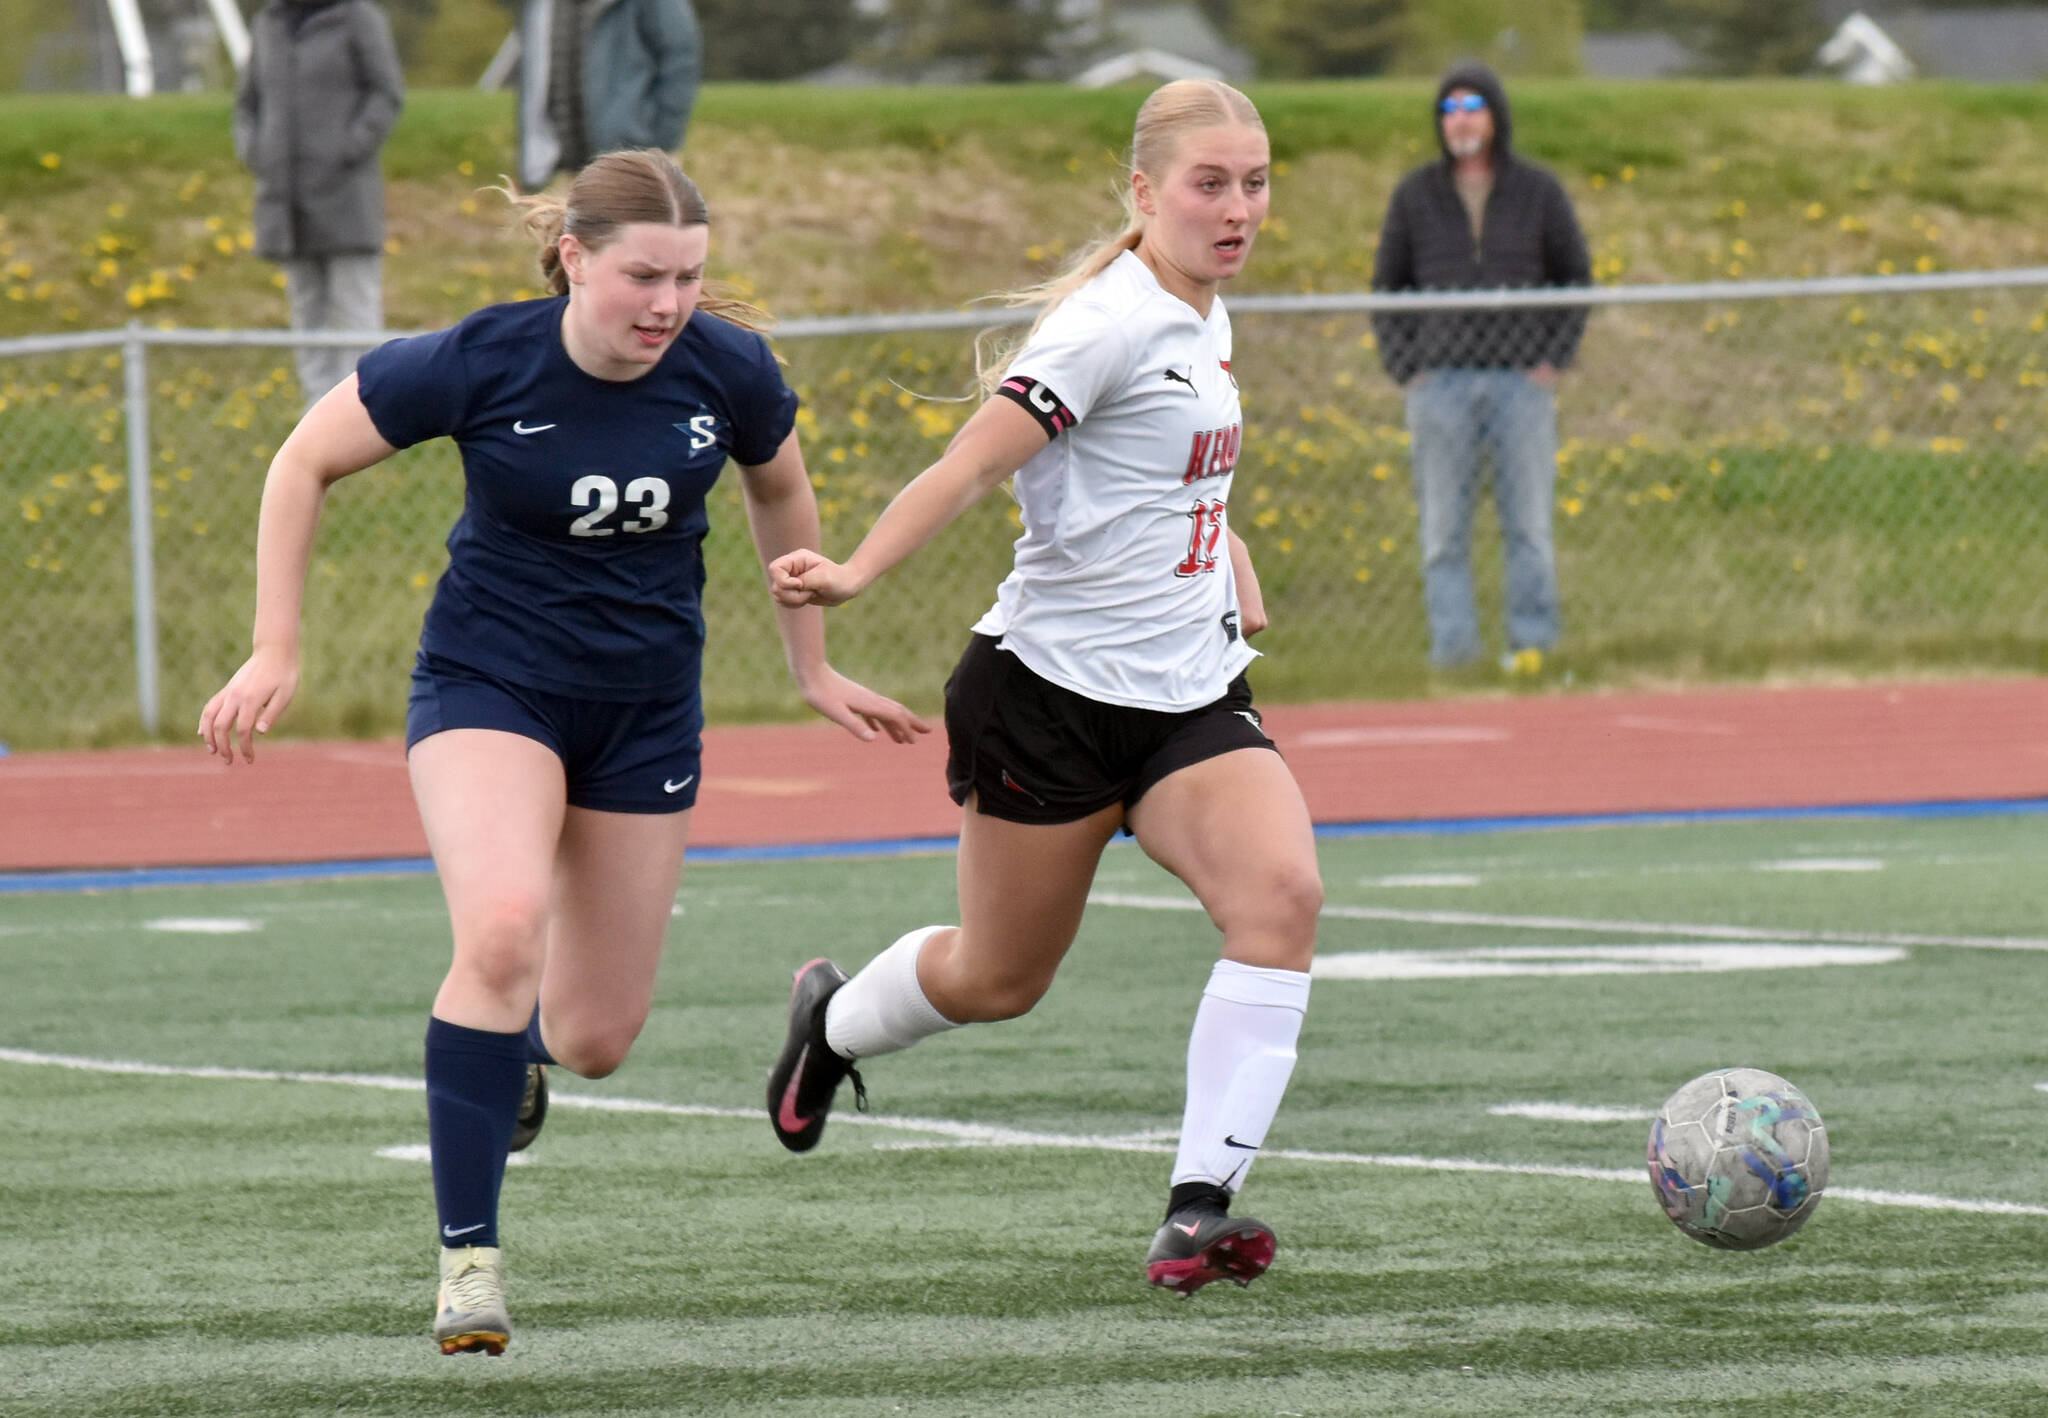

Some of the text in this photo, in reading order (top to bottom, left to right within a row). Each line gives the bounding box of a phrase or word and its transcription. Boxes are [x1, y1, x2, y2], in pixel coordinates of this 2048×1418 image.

[1029, 382, 1056, 413] C
[690, 415, 716, 449] S
[569, 475, 671, 536] 23
